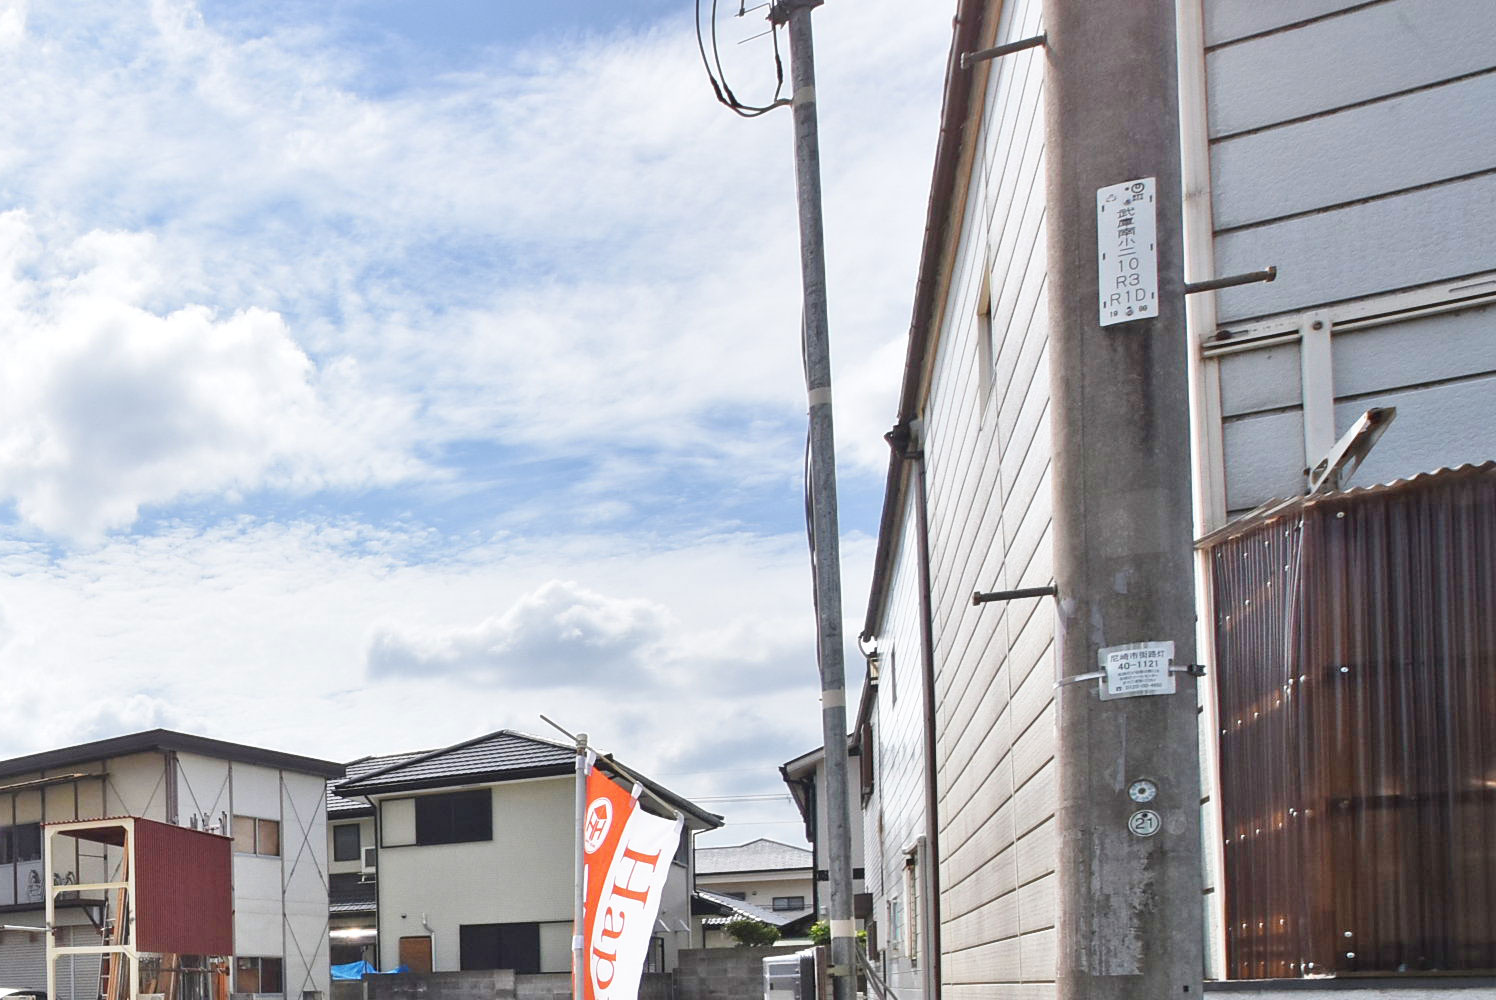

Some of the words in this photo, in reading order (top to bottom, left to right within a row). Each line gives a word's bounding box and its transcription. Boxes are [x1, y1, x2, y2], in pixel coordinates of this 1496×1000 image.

[1116, 273, 1140, 289] R3
[1110, 288, 1146, 306] R1D
[1118, 660, 1158, 670] 40-1121
[1135, 816, 1154, 829] 21
